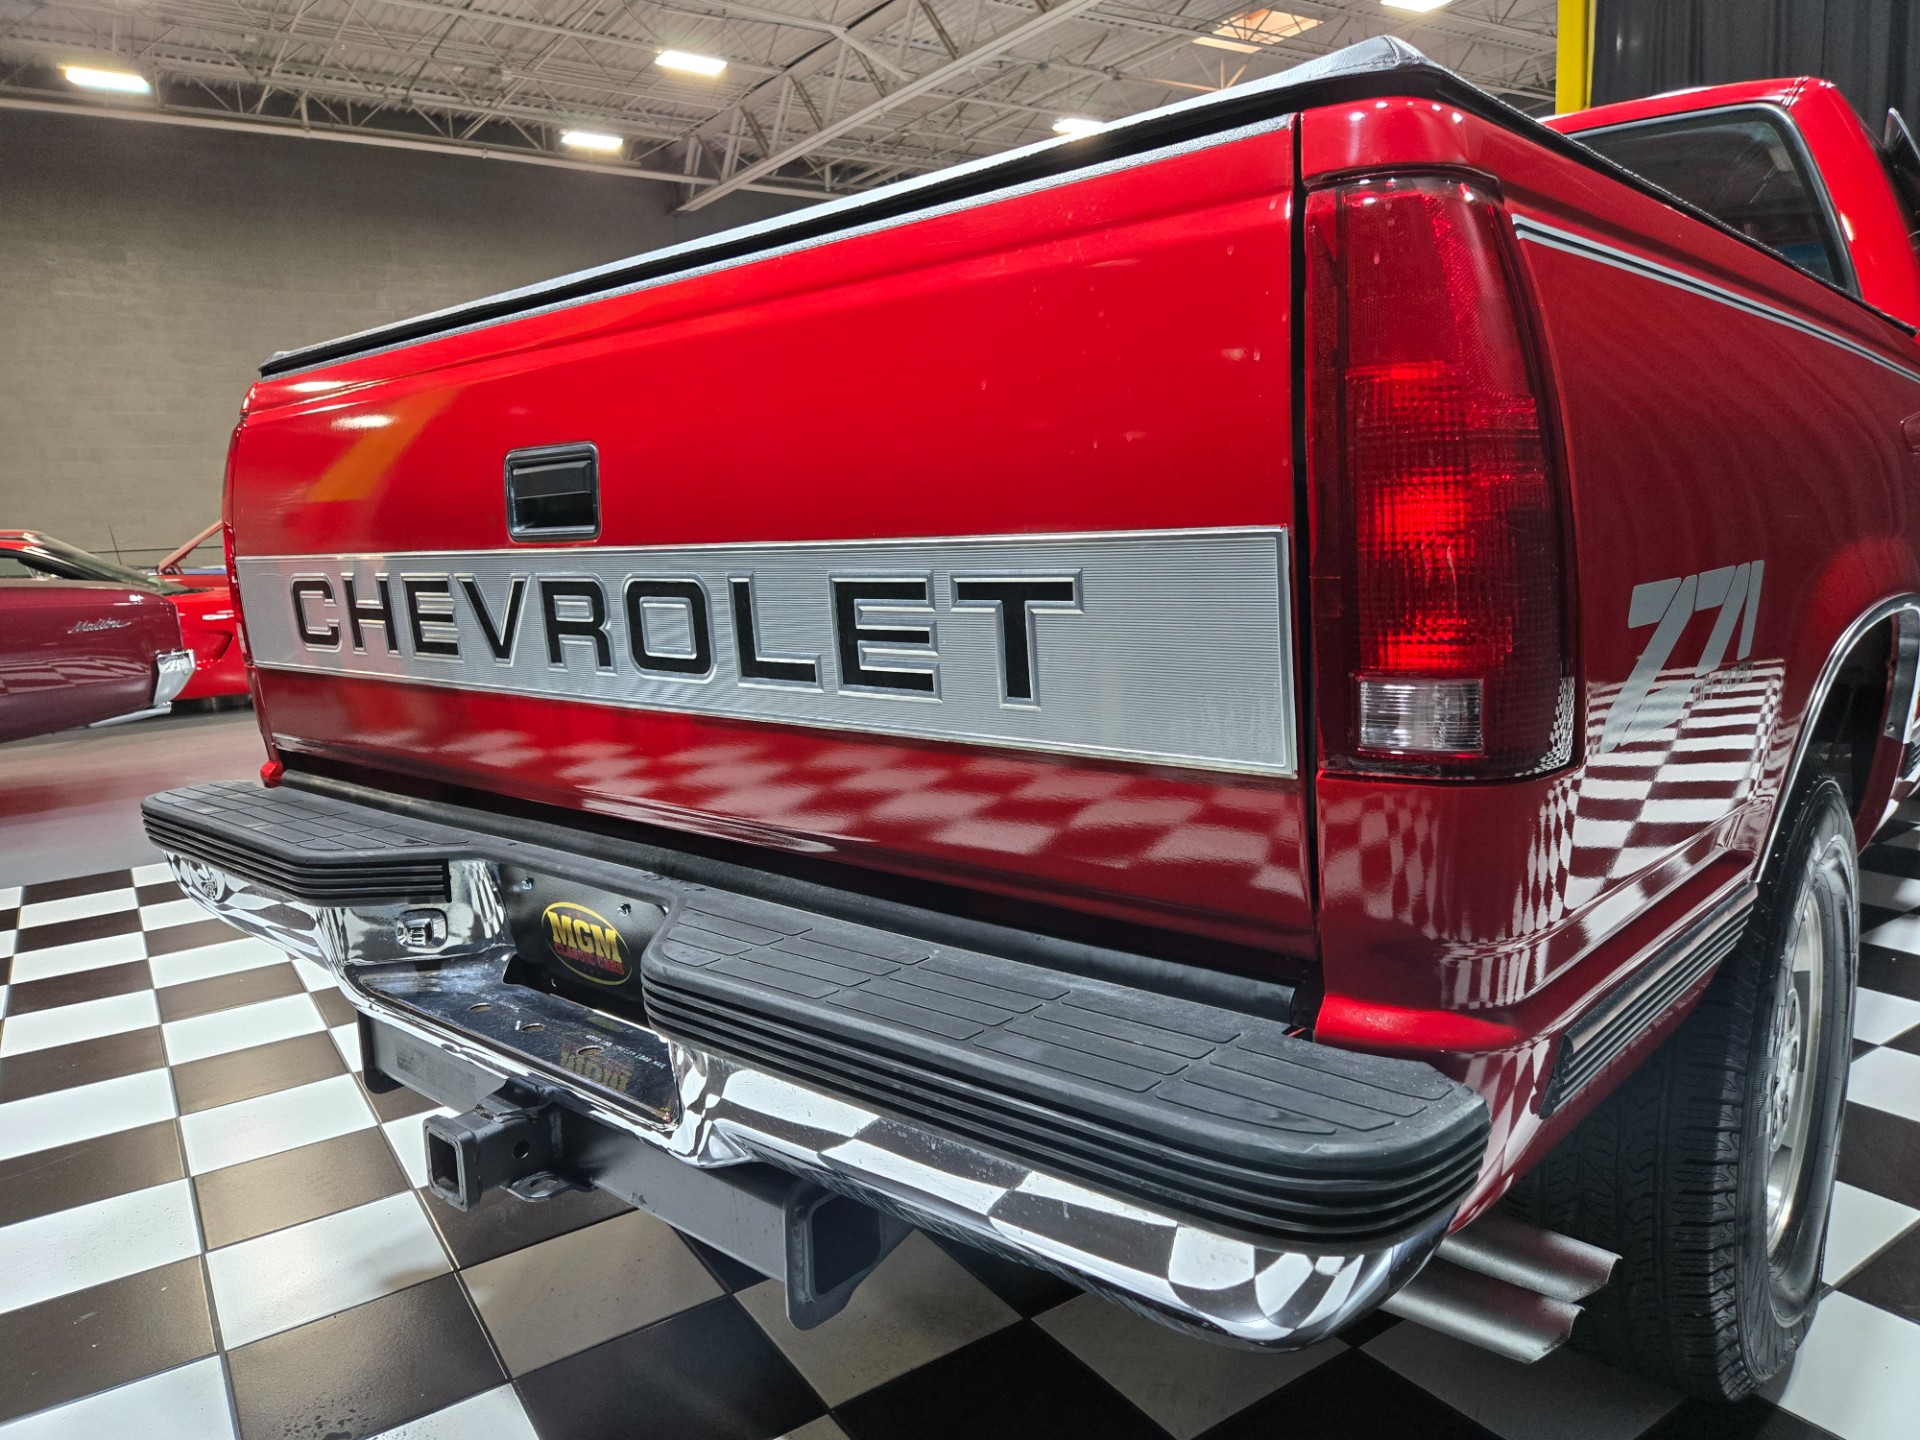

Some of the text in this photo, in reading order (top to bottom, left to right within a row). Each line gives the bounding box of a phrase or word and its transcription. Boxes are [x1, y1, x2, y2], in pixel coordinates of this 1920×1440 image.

[67, 617, 132, 634] Malibu
[290, 568, 1084, 711] CHEVROLET
[547, 910, 623, 963] MGM
[554, 941, 625, 975] CLASSIC CARS
